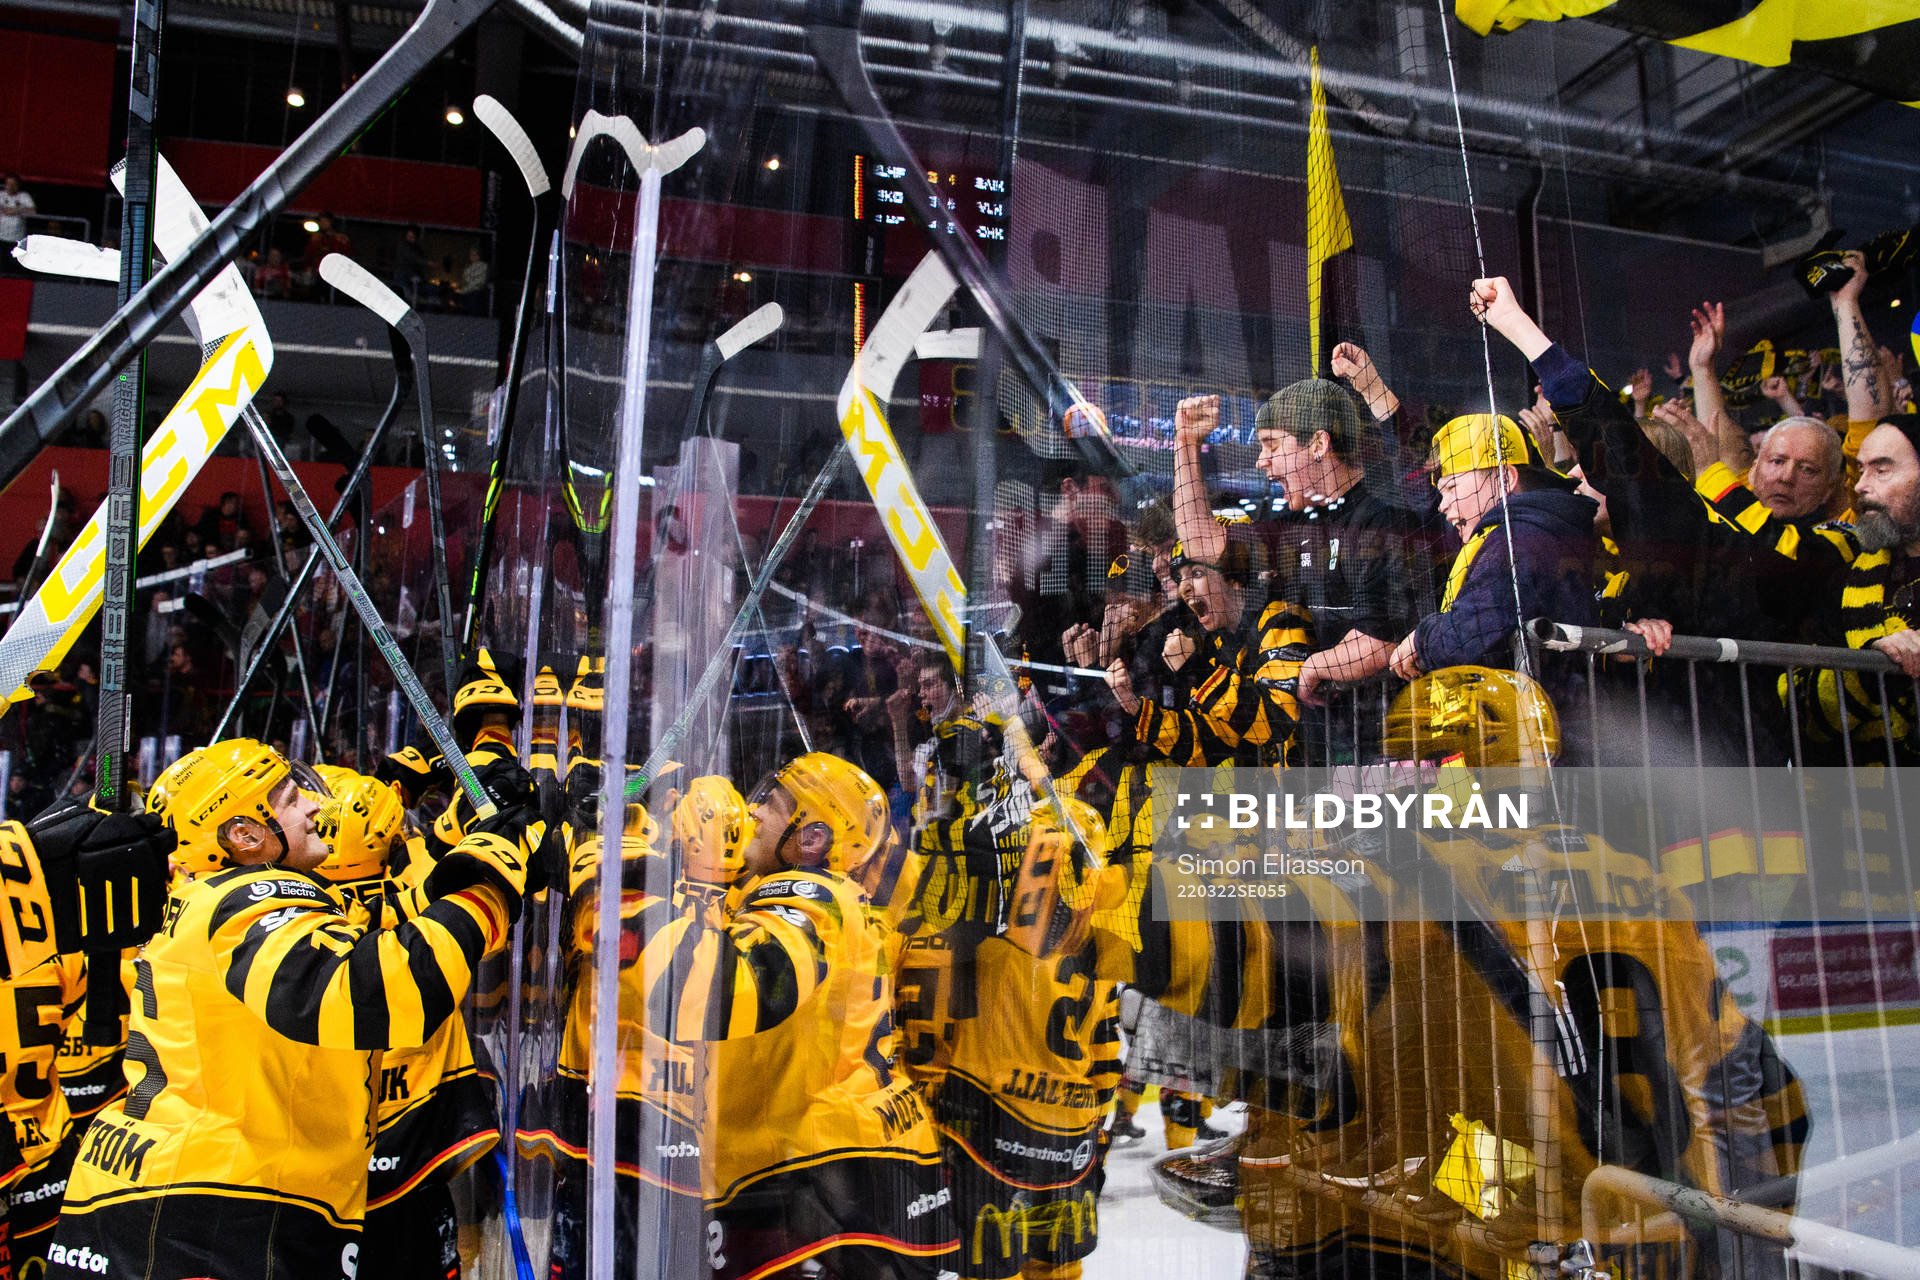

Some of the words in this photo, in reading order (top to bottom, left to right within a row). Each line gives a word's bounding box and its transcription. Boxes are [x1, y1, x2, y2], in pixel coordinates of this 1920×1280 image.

[177, 771, 193, 786] Kraft
[199, 792, 229, 822] CCM
[280, 886, 316, 898] Electro
[47, 1242, 110, 1275] ractor
